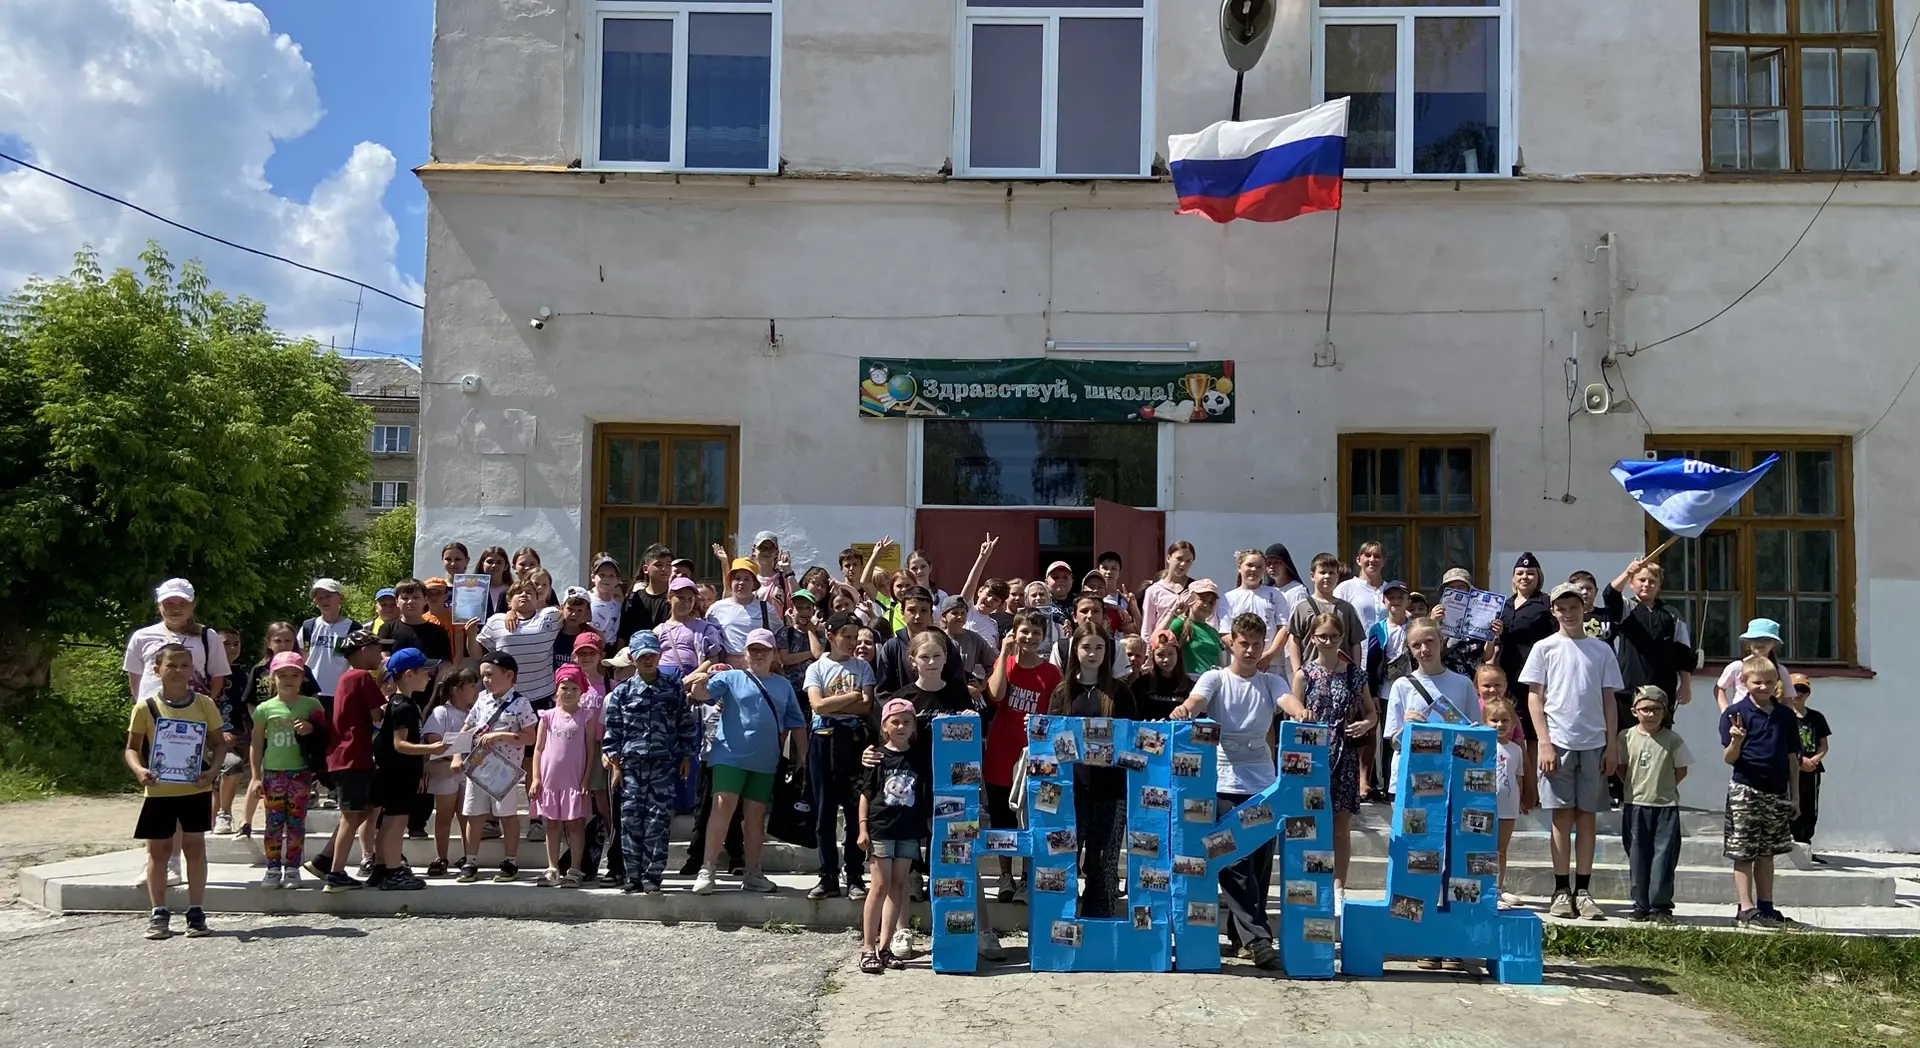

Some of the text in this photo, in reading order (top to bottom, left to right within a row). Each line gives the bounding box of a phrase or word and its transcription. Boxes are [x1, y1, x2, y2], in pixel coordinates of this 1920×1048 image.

[922, 379, 1175, 403] Здравствуй, школа!
[1012, 686, 1041, 703] SIMPLY
